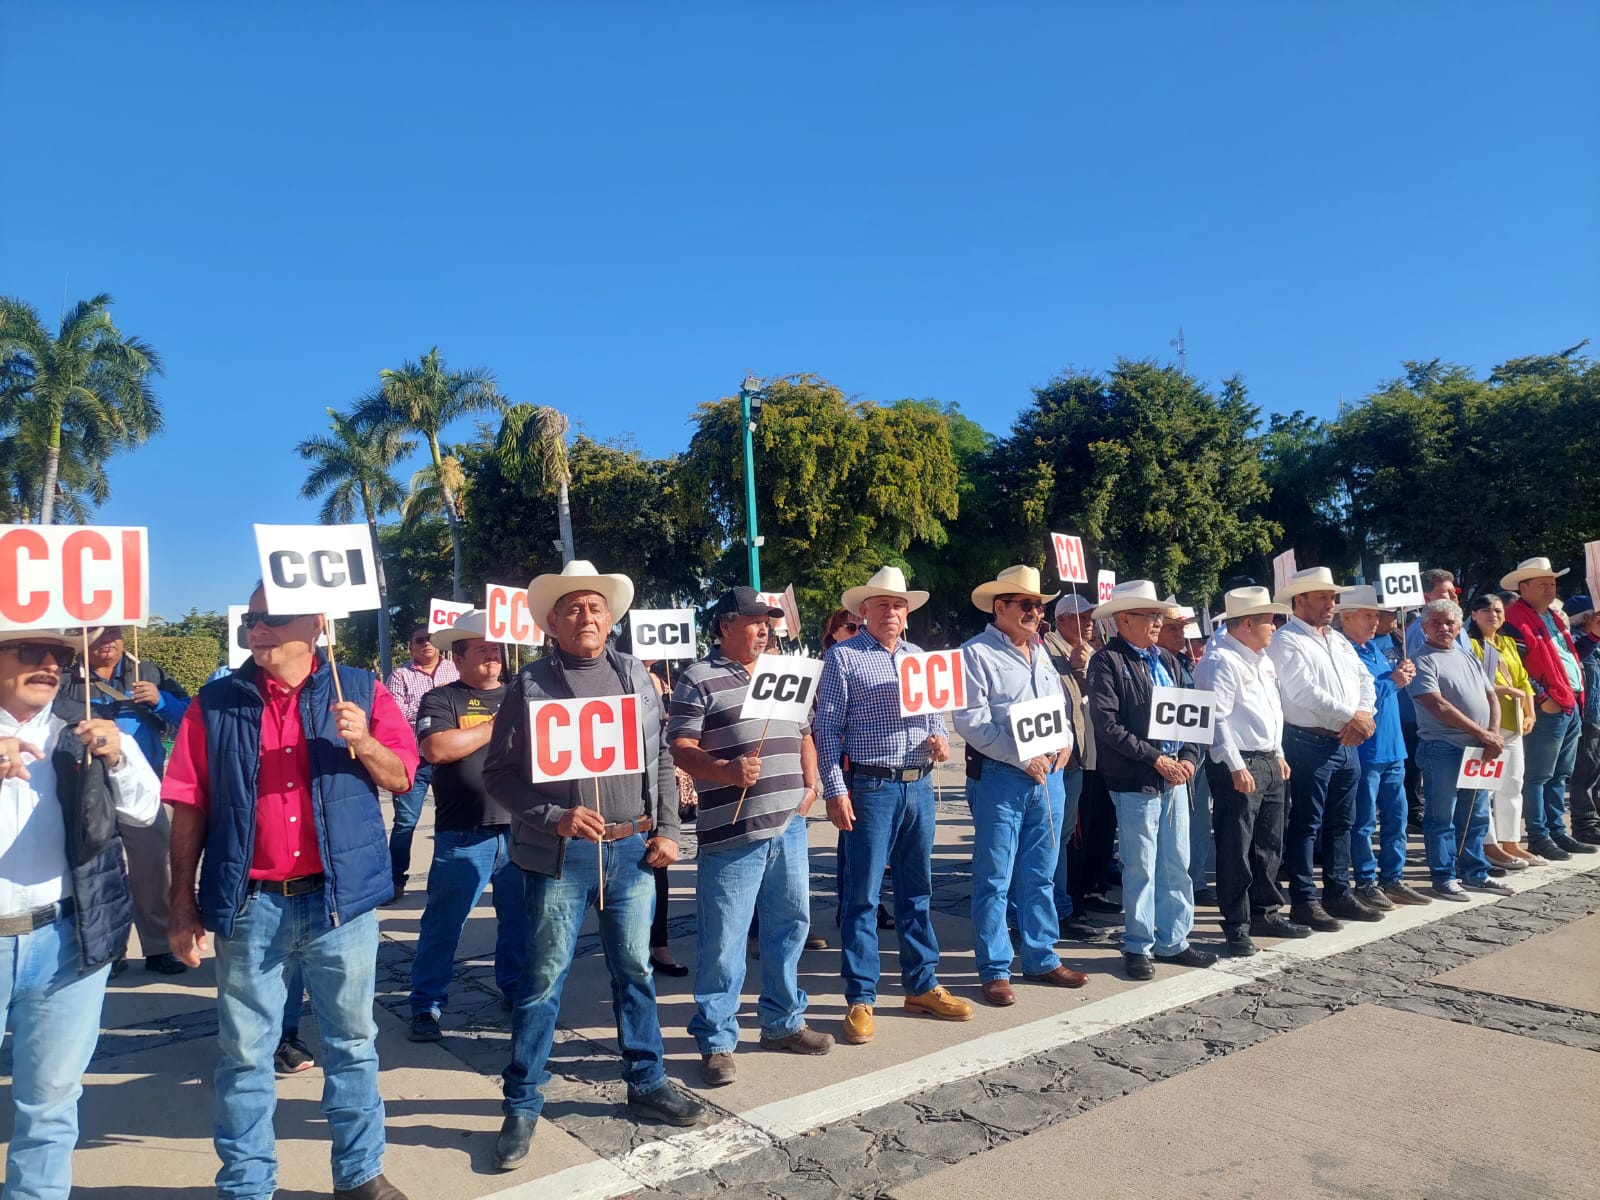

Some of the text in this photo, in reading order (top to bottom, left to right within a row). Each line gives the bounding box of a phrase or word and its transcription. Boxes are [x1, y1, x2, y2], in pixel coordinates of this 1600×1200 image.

[269, 549, 366, 588] CCI
[1055, 536, 1086, 579] CCI
[0, 529, 141, 623] CCI
[1385, 575, 1419, 594] CCI
[433, 610, 460, 626] CC
[637, 623, 690, 645] CCI
[751, 672, 812, 703] CCI
[901, 652, 963, 712] CCI
[1017, 710, 1063, 743] CCI
[1155, 702, 1210, 728] CCI
[535, 698, 639, 777] CCI
[1464, 759, 1504, 778] CCI
